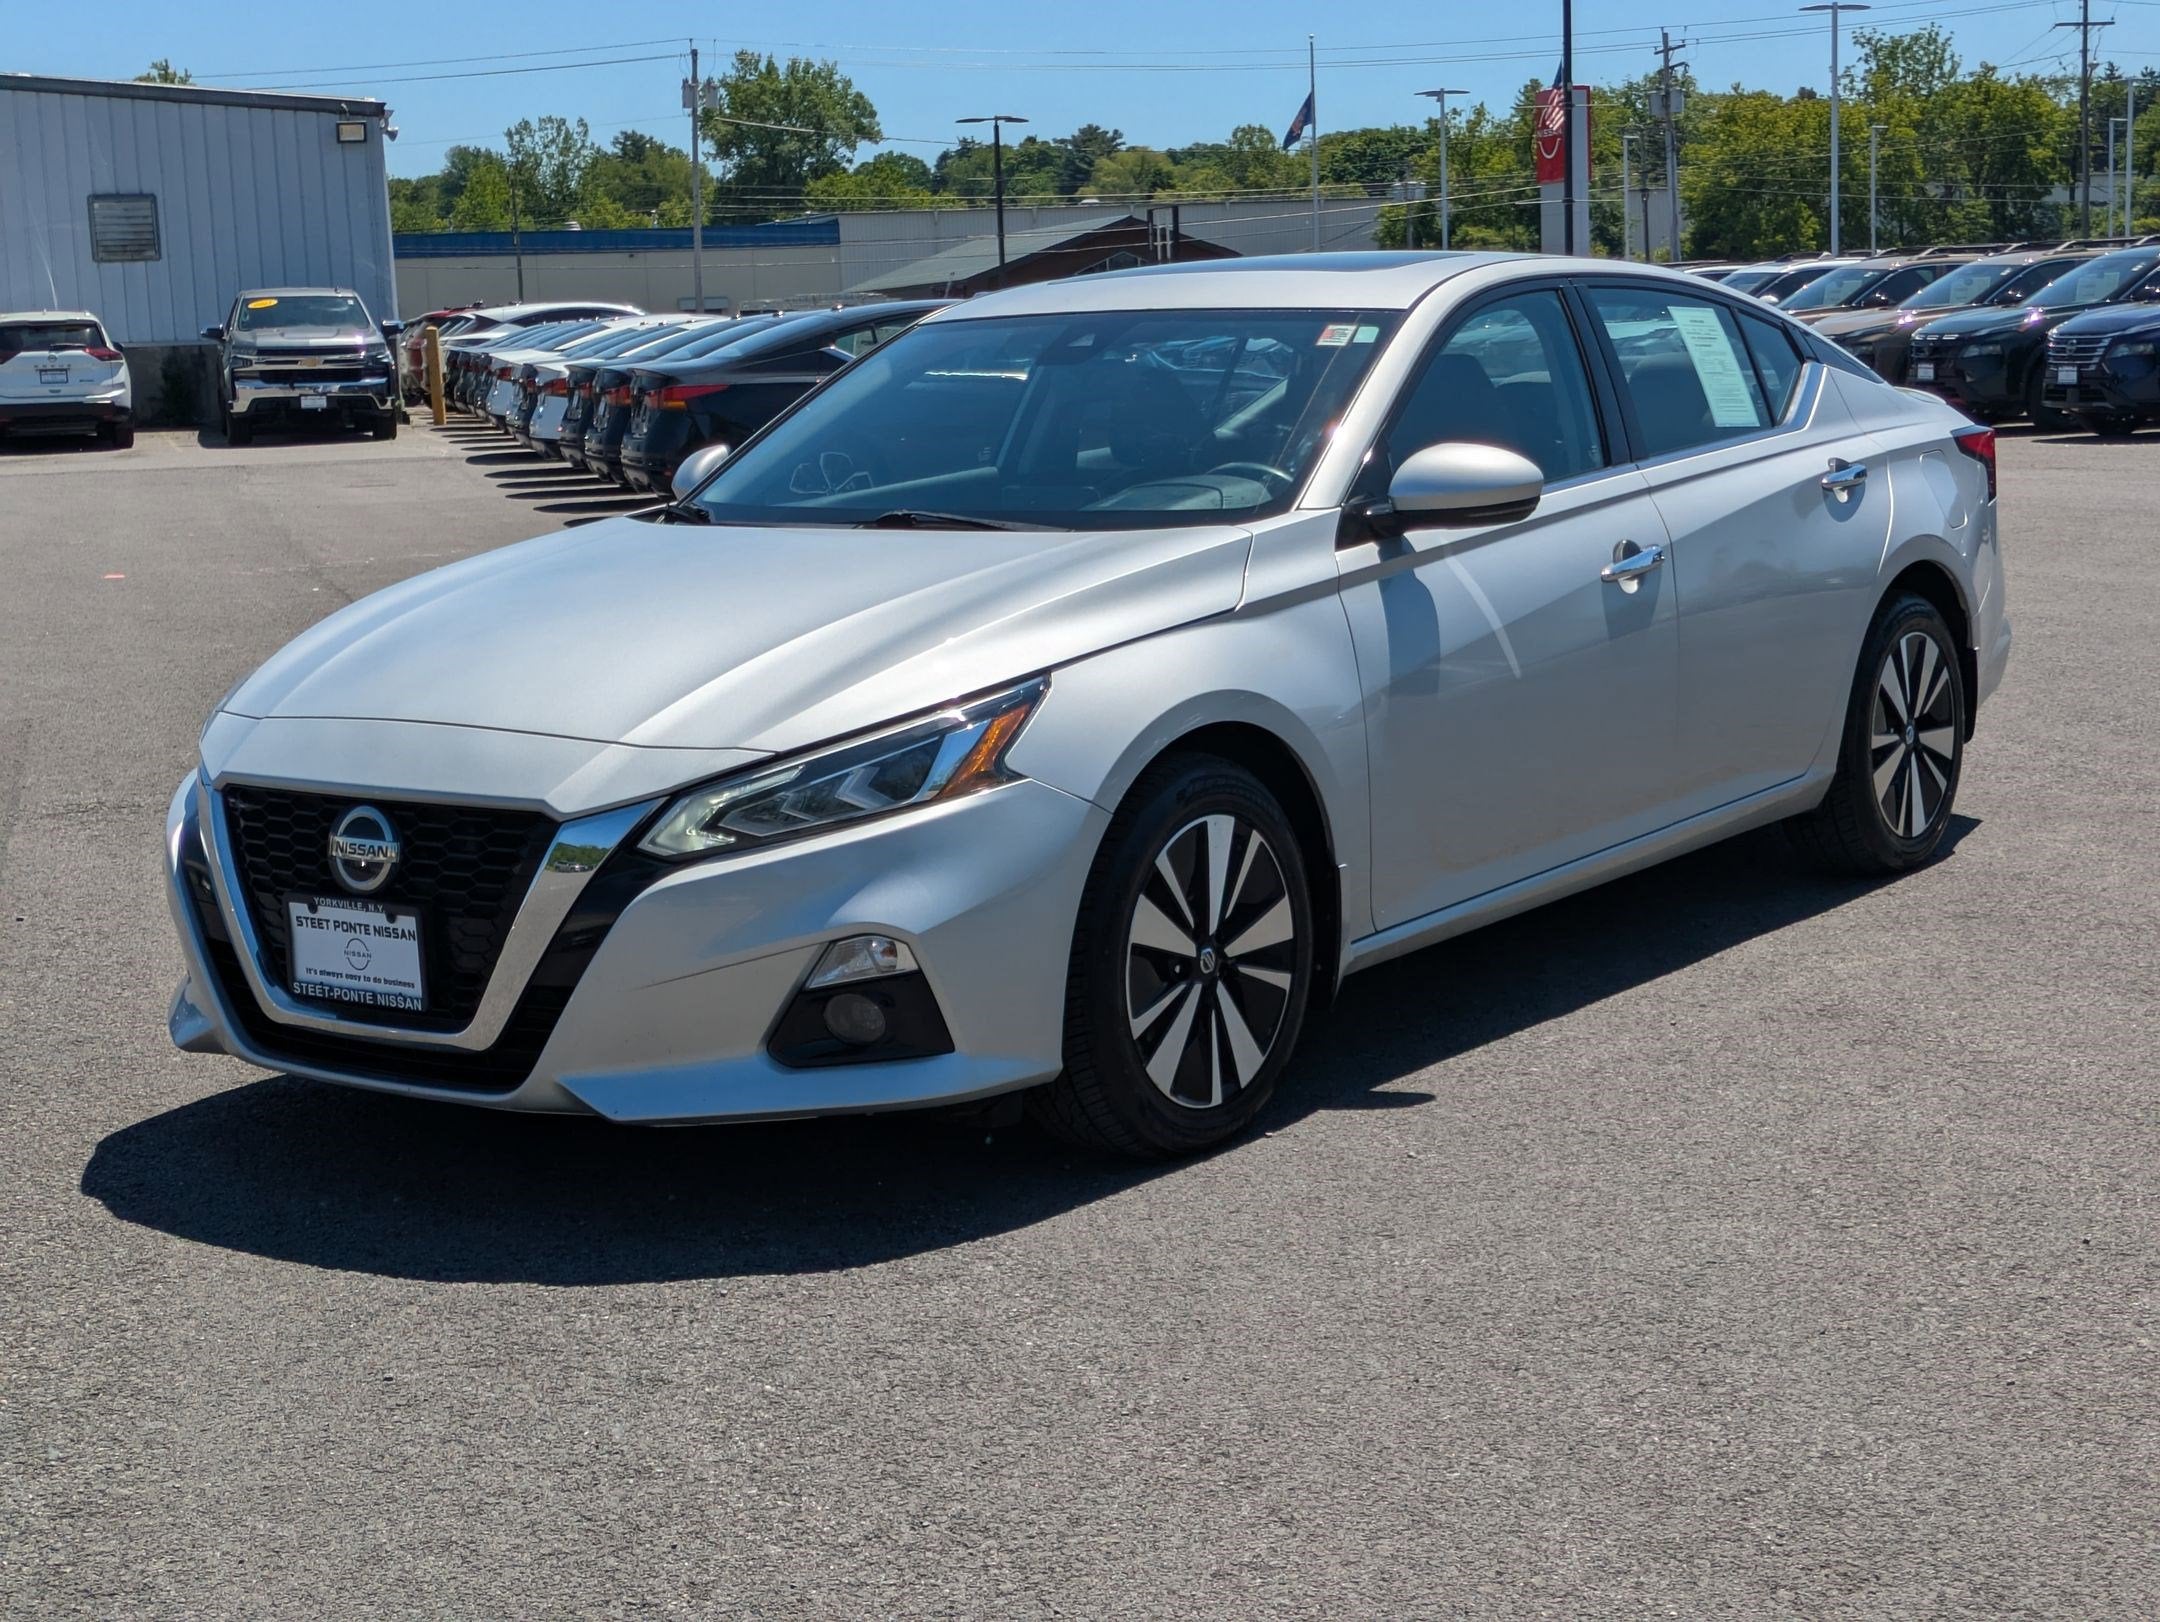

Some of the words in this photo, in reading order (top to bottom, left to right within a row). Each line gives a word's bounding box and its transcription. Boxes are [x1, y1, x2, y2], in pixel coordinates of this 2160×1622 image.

[336, 840, 389, 858] NISSAN
[296, 915, 330, 931] STEET
[333, 920, 371, 936] PONTE
[373, 925, 416, 942] NISSAN
[344, 949, 372, 959] NISSAN
[319, 969, 344, 979] always
[345, 973, 361, 982] easy
[363, 975, 371, 983] to
[372, 976, 382, 984] do
[383, 978, 415, 989] business
[293, 981, 374, 1004] STEET-PONTE
[377, 993, 422, 1011] NISSAN
